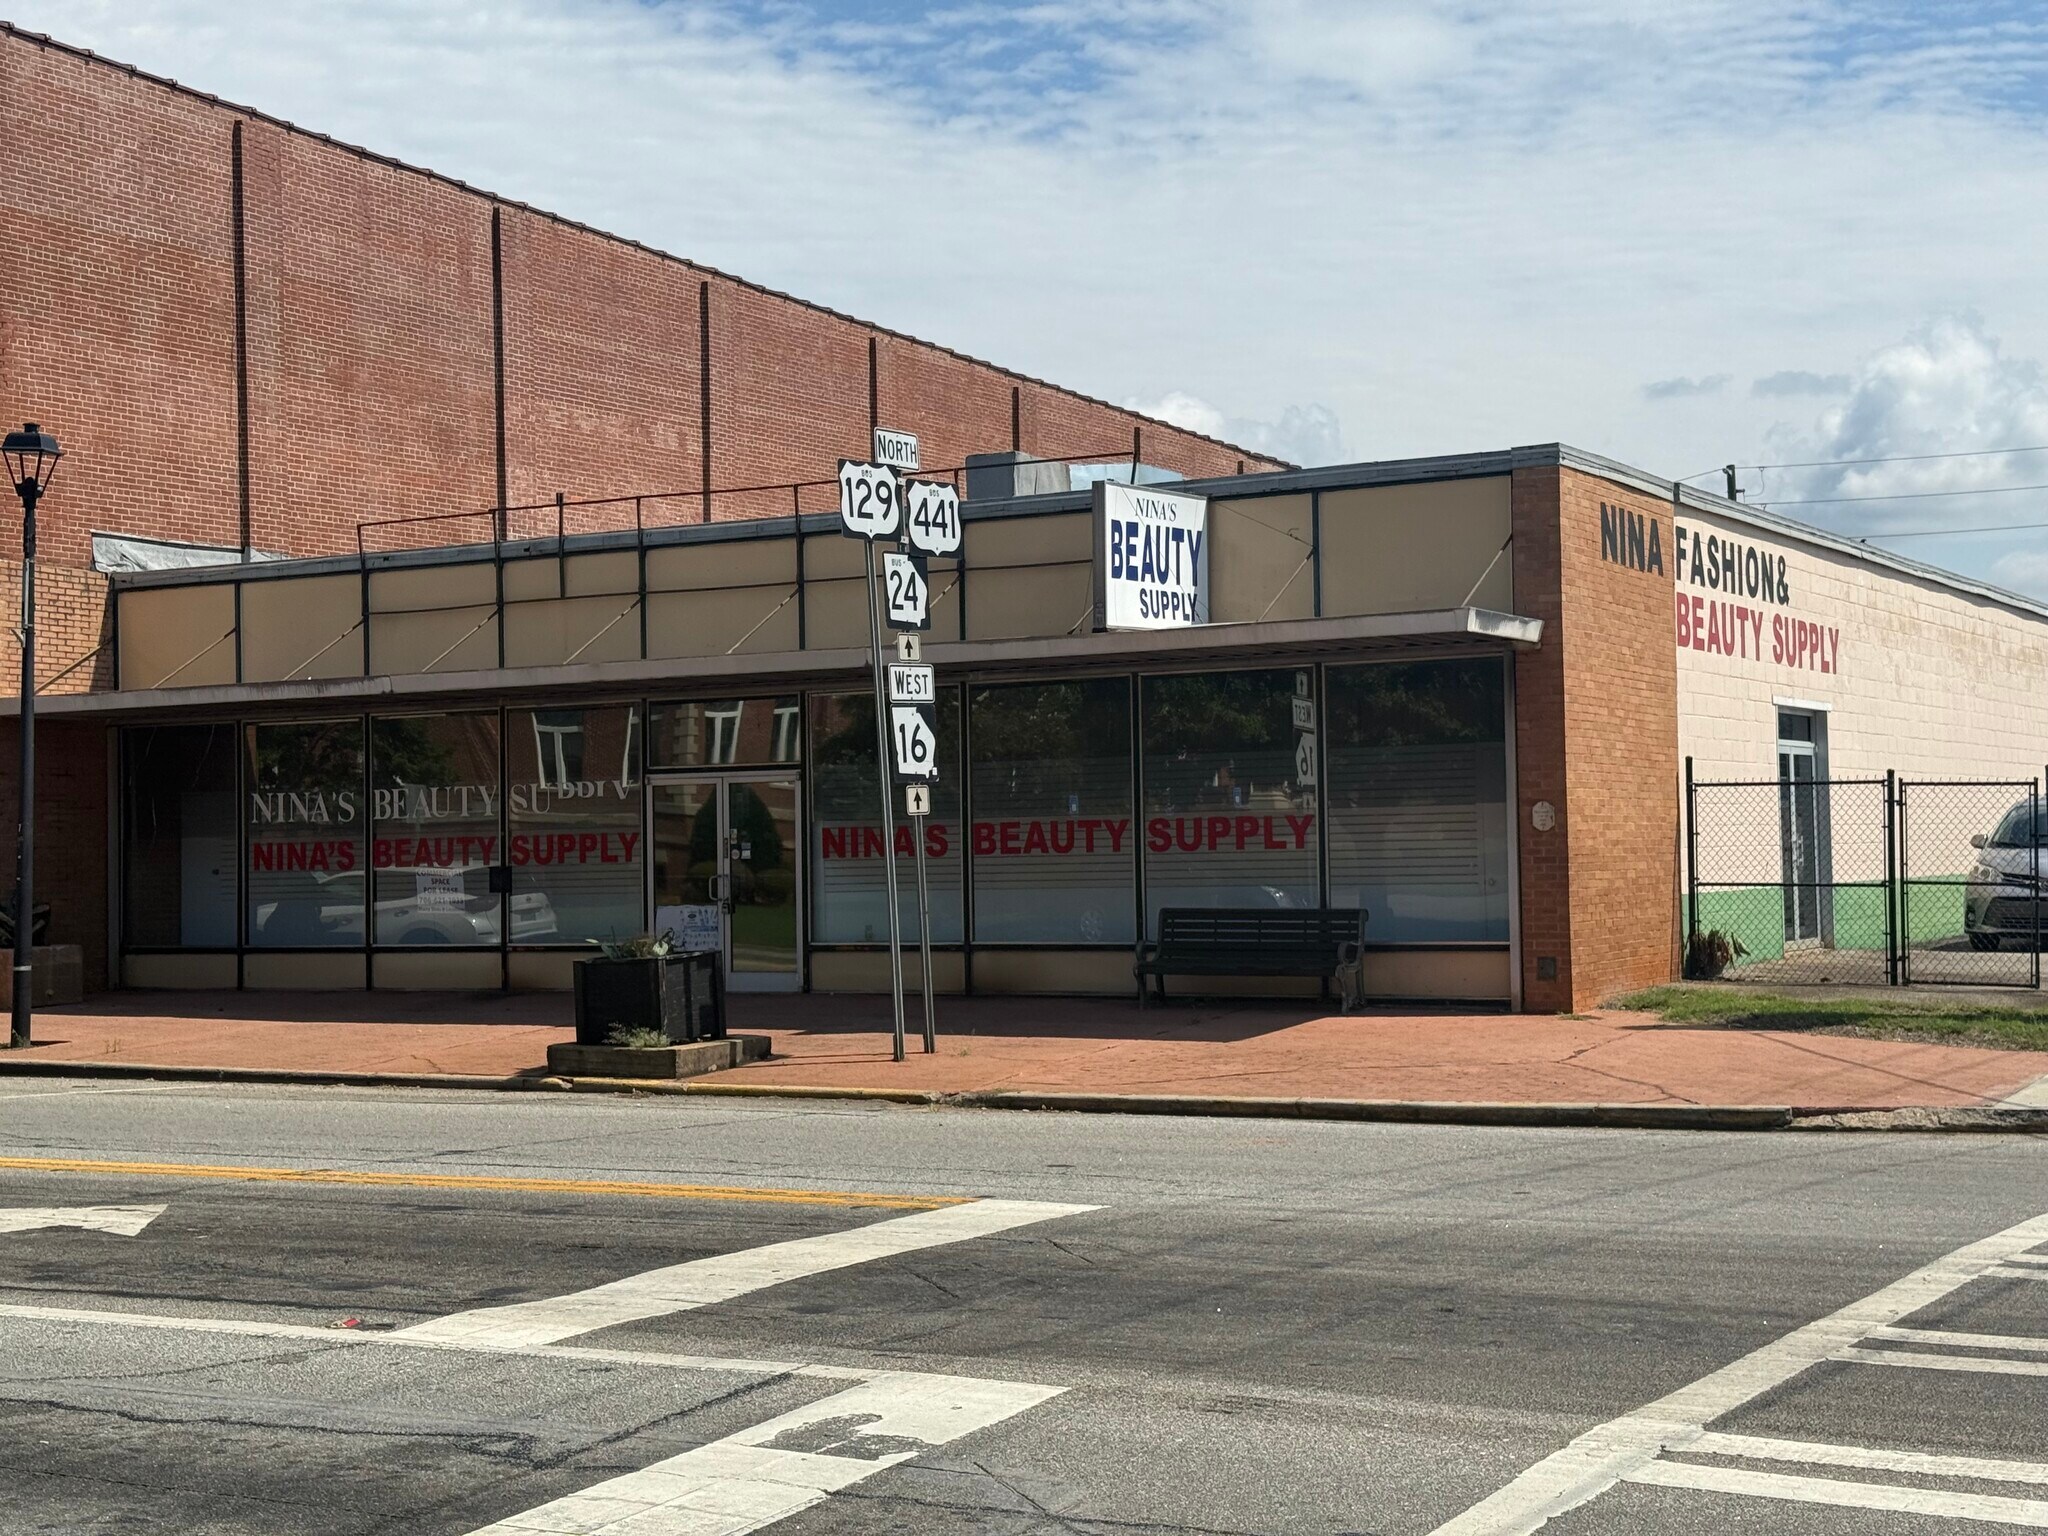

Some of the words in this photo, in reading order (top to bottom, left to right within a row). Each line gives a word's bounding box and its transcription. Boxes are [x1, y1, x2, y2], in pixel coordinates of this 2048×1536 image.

[877, 435, 917, 463] NORTH
[845, 476, 893, 522] 129
[914, 497, 956, 540] 441
[1134, 497, 1177, 522] NINA'S
[1111, 519, 1203, 588] BEAUTY
[1600, 501, 1663, 577] NINA
[891, 558, 902, 567] BUS
[889, 569, 919, 612] 24
[1139, 588, 1198, 623] SUPPLY
[1676, 592, 1764, 662] BEAUTY
[1772, 613, 1840, 675] SUPPLY
[893, 670, 929, 696] WEST
[899, 723, 928, 764] 16
[251, 791, 356, 825] NINA'S
[373, 784, 497, 820] BEAUTY
[252, 840, 356, 872] NINA'S
[373, 836, 497, 869] BEAUTY
[511, 832, 640, 866] SUPPLY
[821, 824, 949, 859] NINAS
[972, 819, 1130, 856] BEAUTY
[1147, 814, 1315, 853] SUPPLY
